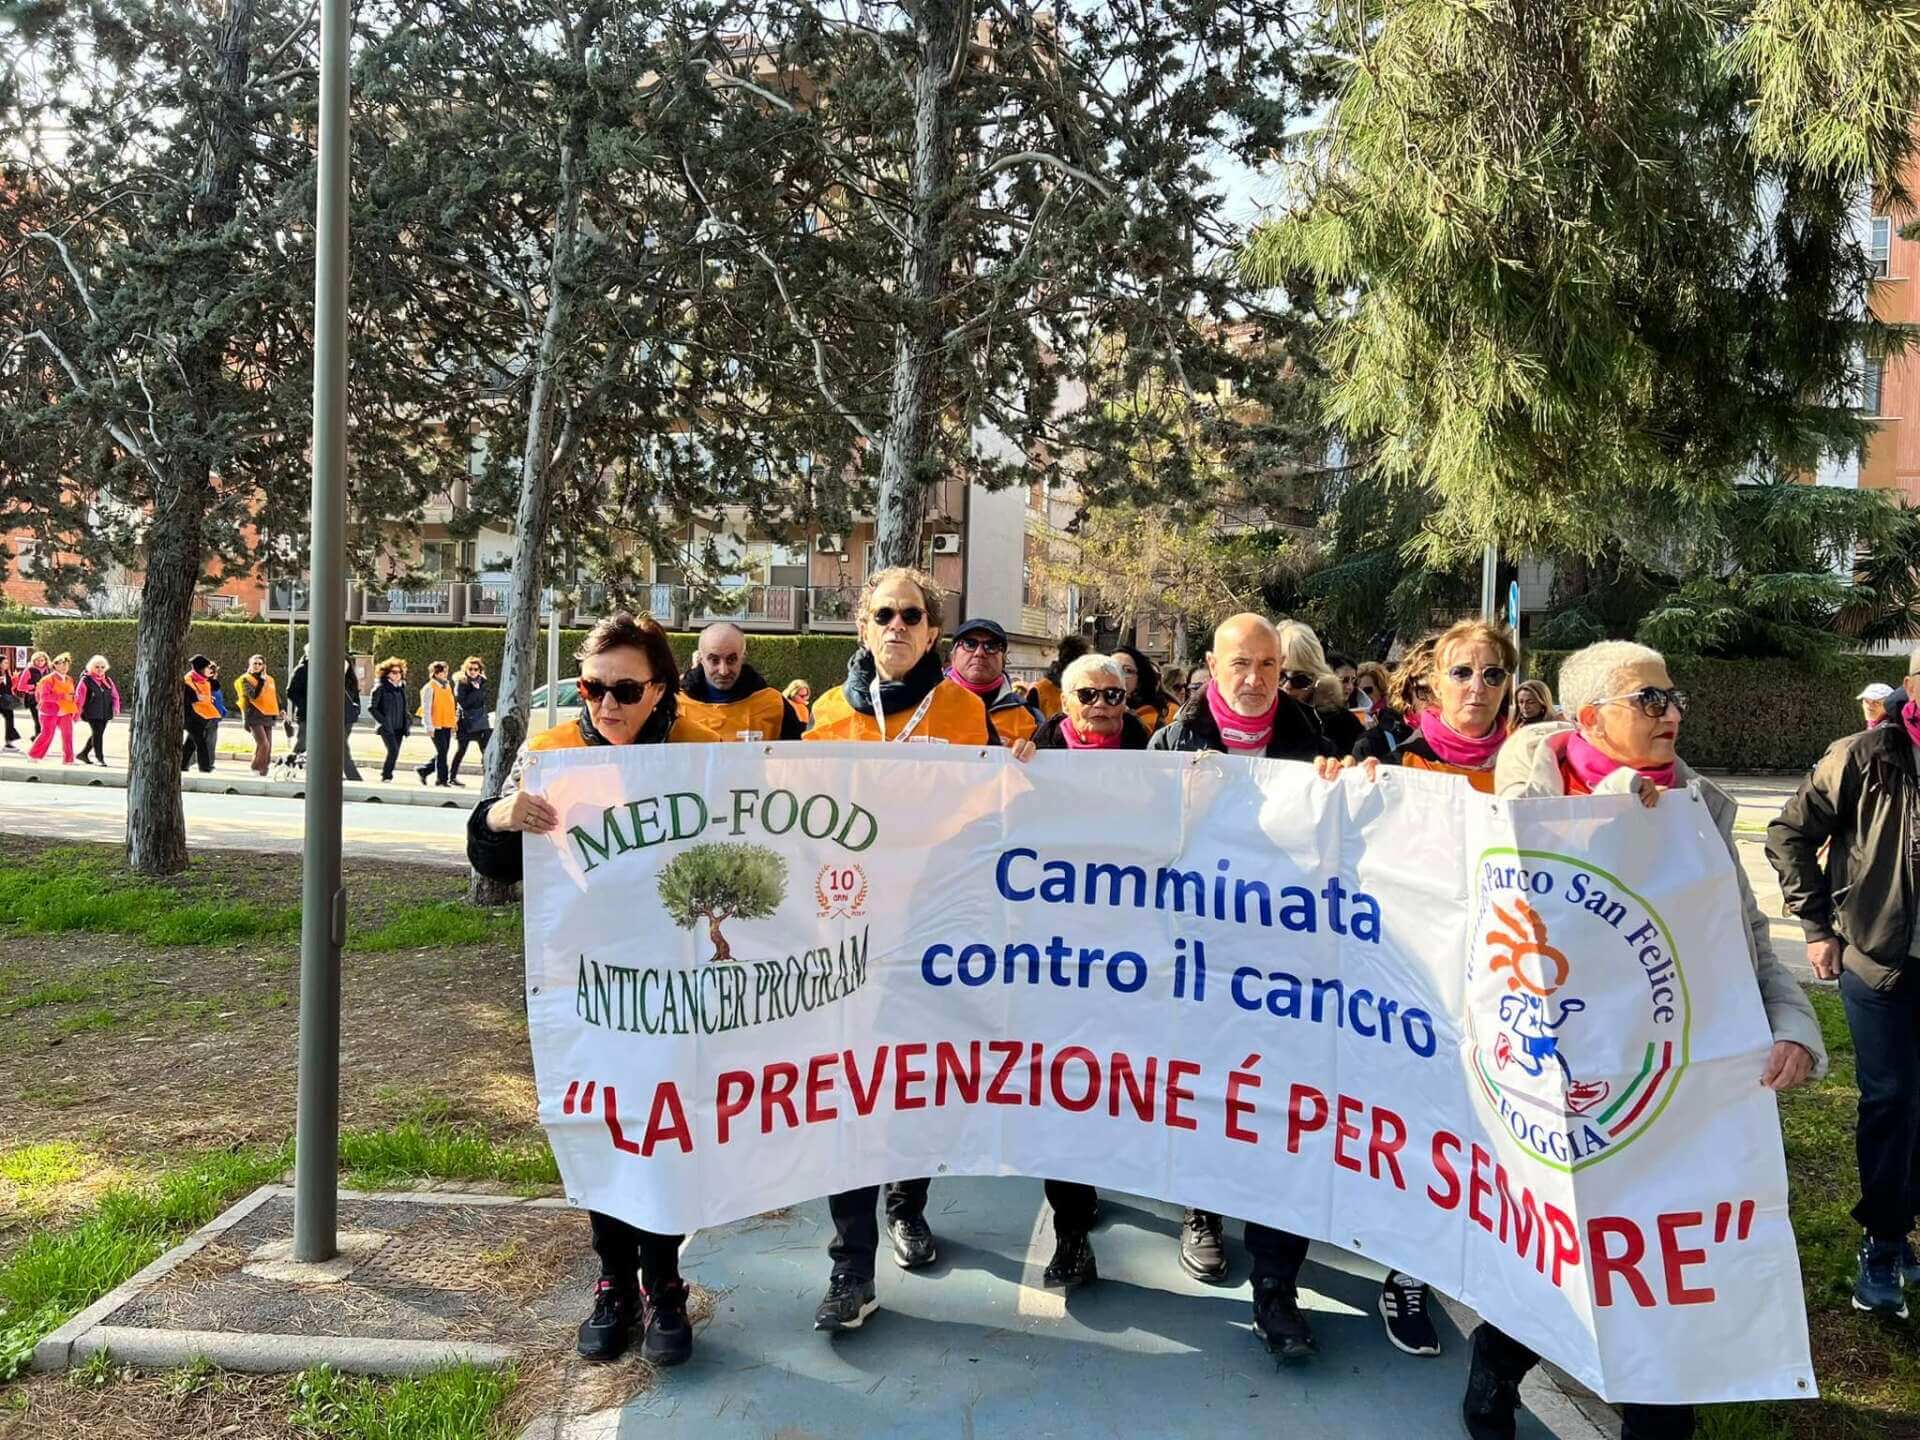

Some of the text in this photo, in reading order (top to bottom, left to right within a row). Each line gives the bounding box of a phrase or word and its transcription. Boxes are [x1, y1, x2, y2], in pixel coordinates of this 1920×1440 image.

[567, 789, 878, 873] MED-FOOD
[830, 869, 854, 891] 10
[995, 847, 1382, 944] Camminata
[1484, 861, 1676, 1024] Parco San Felice
[576, 924, 869, 1034] ANTICANCER PROGRAM
[920, 935, 1438, 1059] contro il cancro
[715, 1039, 1202, 1145] PREVENZIONE
[1223, 1053, 1262, 1145] É
[1286, 1083, 1409, 1192] PER
[1500, 1097, 1611, 1163] FOGGIA
